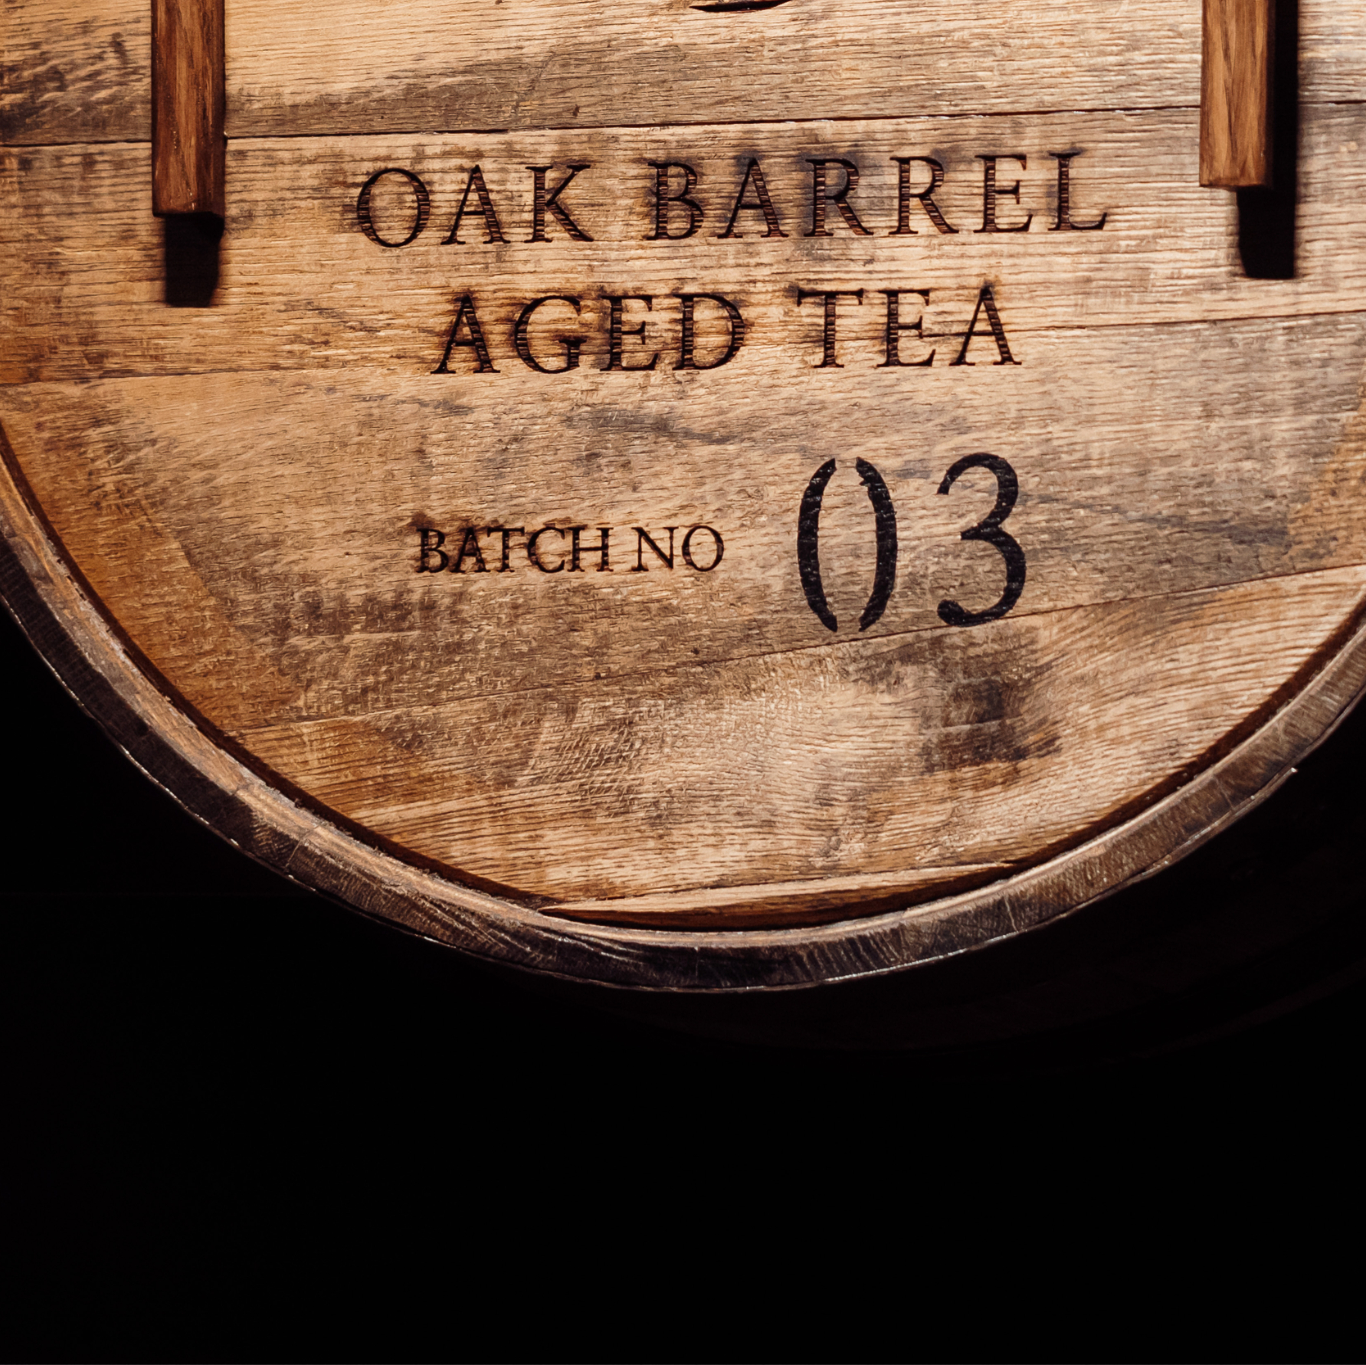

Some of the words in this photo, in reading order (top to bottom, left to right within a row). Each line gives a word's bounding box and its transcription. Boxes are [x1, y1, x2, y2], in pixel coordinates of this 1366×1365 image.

[355, 162, 594, 248] OAK
[645, 150, 1109, 240] BARREL
[428, 291, 746, 375] AGED
[795, 283, 1023, 369] TEA
[414, 525, 615, 574] BATCH
[631, 524, 725, 573] NO
[795, 452, 1028, 633] 03
